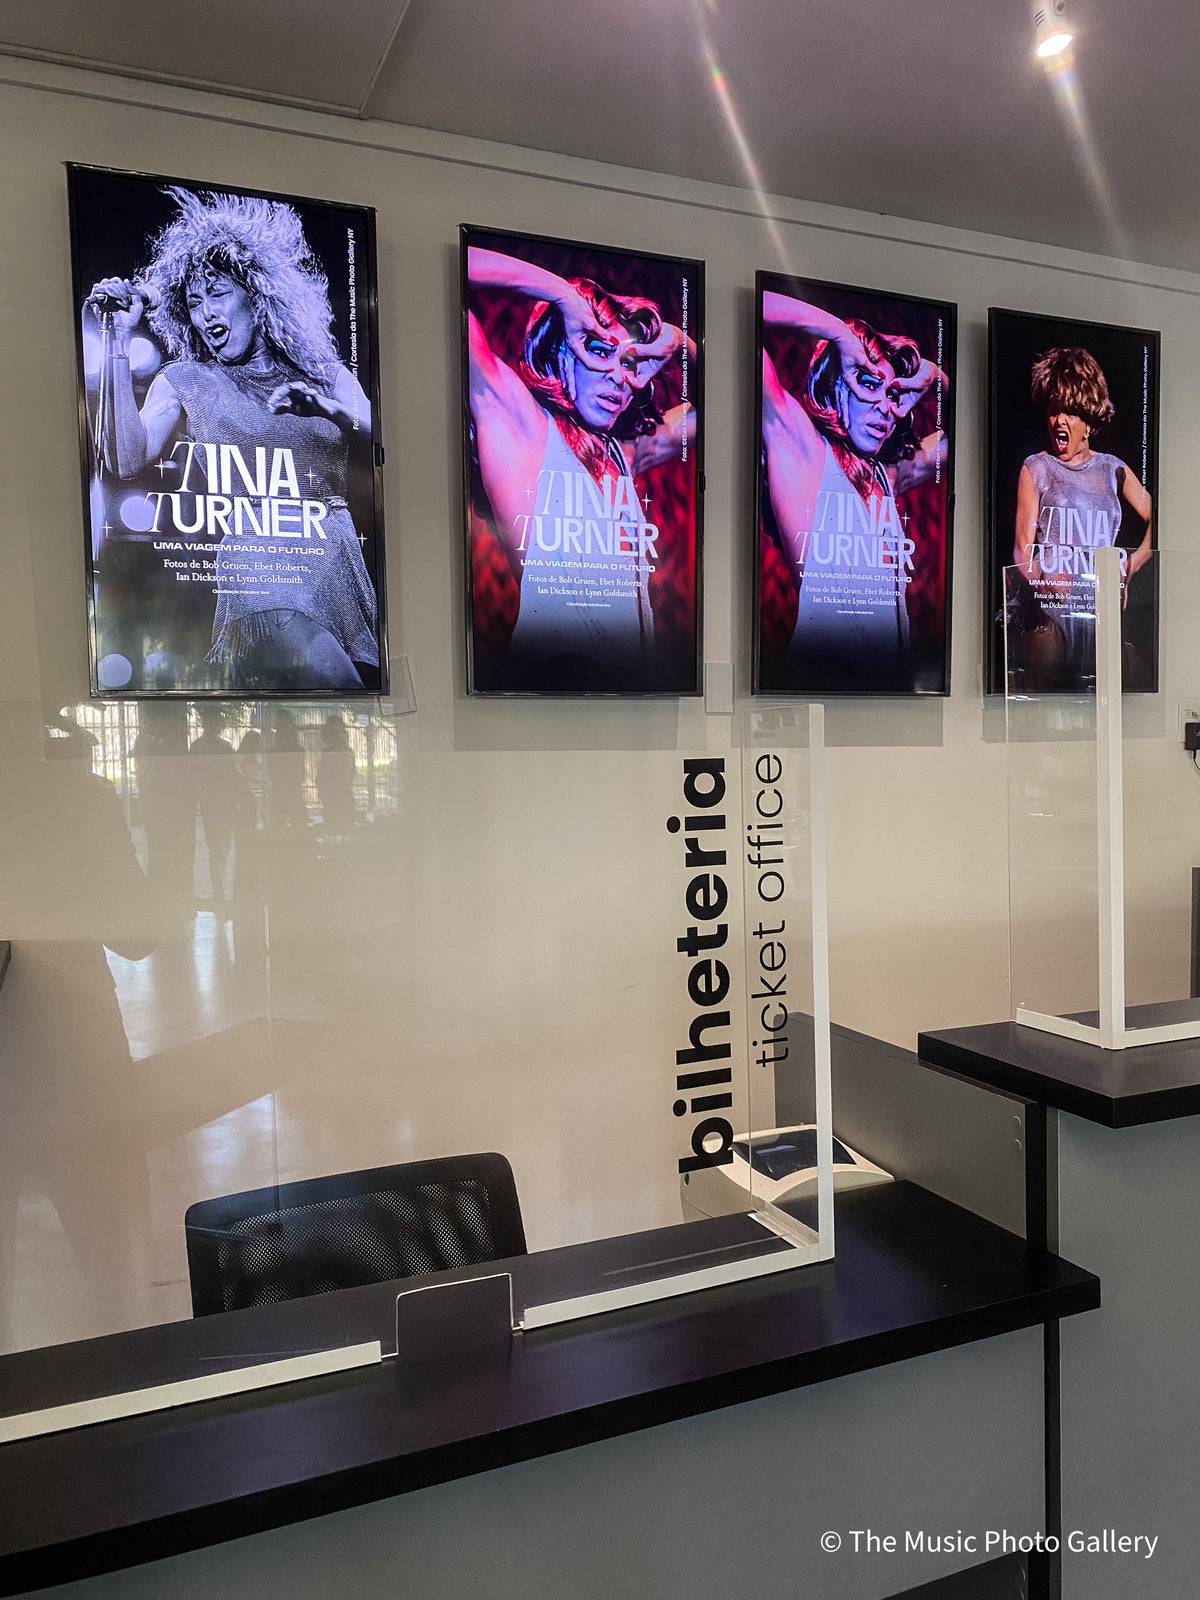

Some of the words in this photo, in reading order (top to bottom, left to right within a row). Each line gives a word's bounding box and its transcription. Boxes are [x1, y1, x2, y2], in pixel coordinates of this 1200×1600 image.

[347, 228, 354, 238] NY
[682, 278, 688, 287] NY
[350, 322, 356, 331] da
[682, 361, 687, 370] da
[170, 441, 300, 497] TINA
[536, 470, 638, 520] TINA
[144, 492, 328, 539] TURNER
[815, 490, 898, 536] TINA
[512, 514, 659, 558] TURNER
[1039, 506, 1112, 548] TINA
[153, 541, 183, 550] UMA
[184, 543, 231, 552] VIAGEM
[233, 545, 266, 553] PARA
[278, 547, 324, 555] FUTURO
[794, 531, 916, 570] TURNER
[163, 559, 188, 569] Fotos
[189, 559, 200, 569] de
[202, 560, 219, 569] Bob
[222, 561, 252, 571] Gruen,
[254, 562, 273, 571] Ebet
[276, 563, 312, 573] Roberts,
[545, 560, 582, 568] VIAGEM
[619, 564, 656, 572] FUTURO
[1024, 544, 1128, 577] TURNR
[176, 572, 190, 581] Ian
[192, 572, 227, 582] Dickson
[236, 574, 257, 586] Lynn
[259, 574, 303, 584] Goldsmith
[528, 575, 547, 583] Fotos
[559, 576, 572, 584] Bob
[574, 577, 598, 586] Gruen,
[616, 578, 644, 588] Roberts,
[550, 587, 578, 595] Dickson
[585, 588, 602, 598] Lynn
[603, 589, 638, 598] Goldsmith
[852, 597, 866, 607] Lynn
[868, 598, 897, 606] Goldsmith
[747, 754, 786, 902] office
[667, 758, 734, 1174] bilheteria
[752, 920, 790, 1068] ticket
